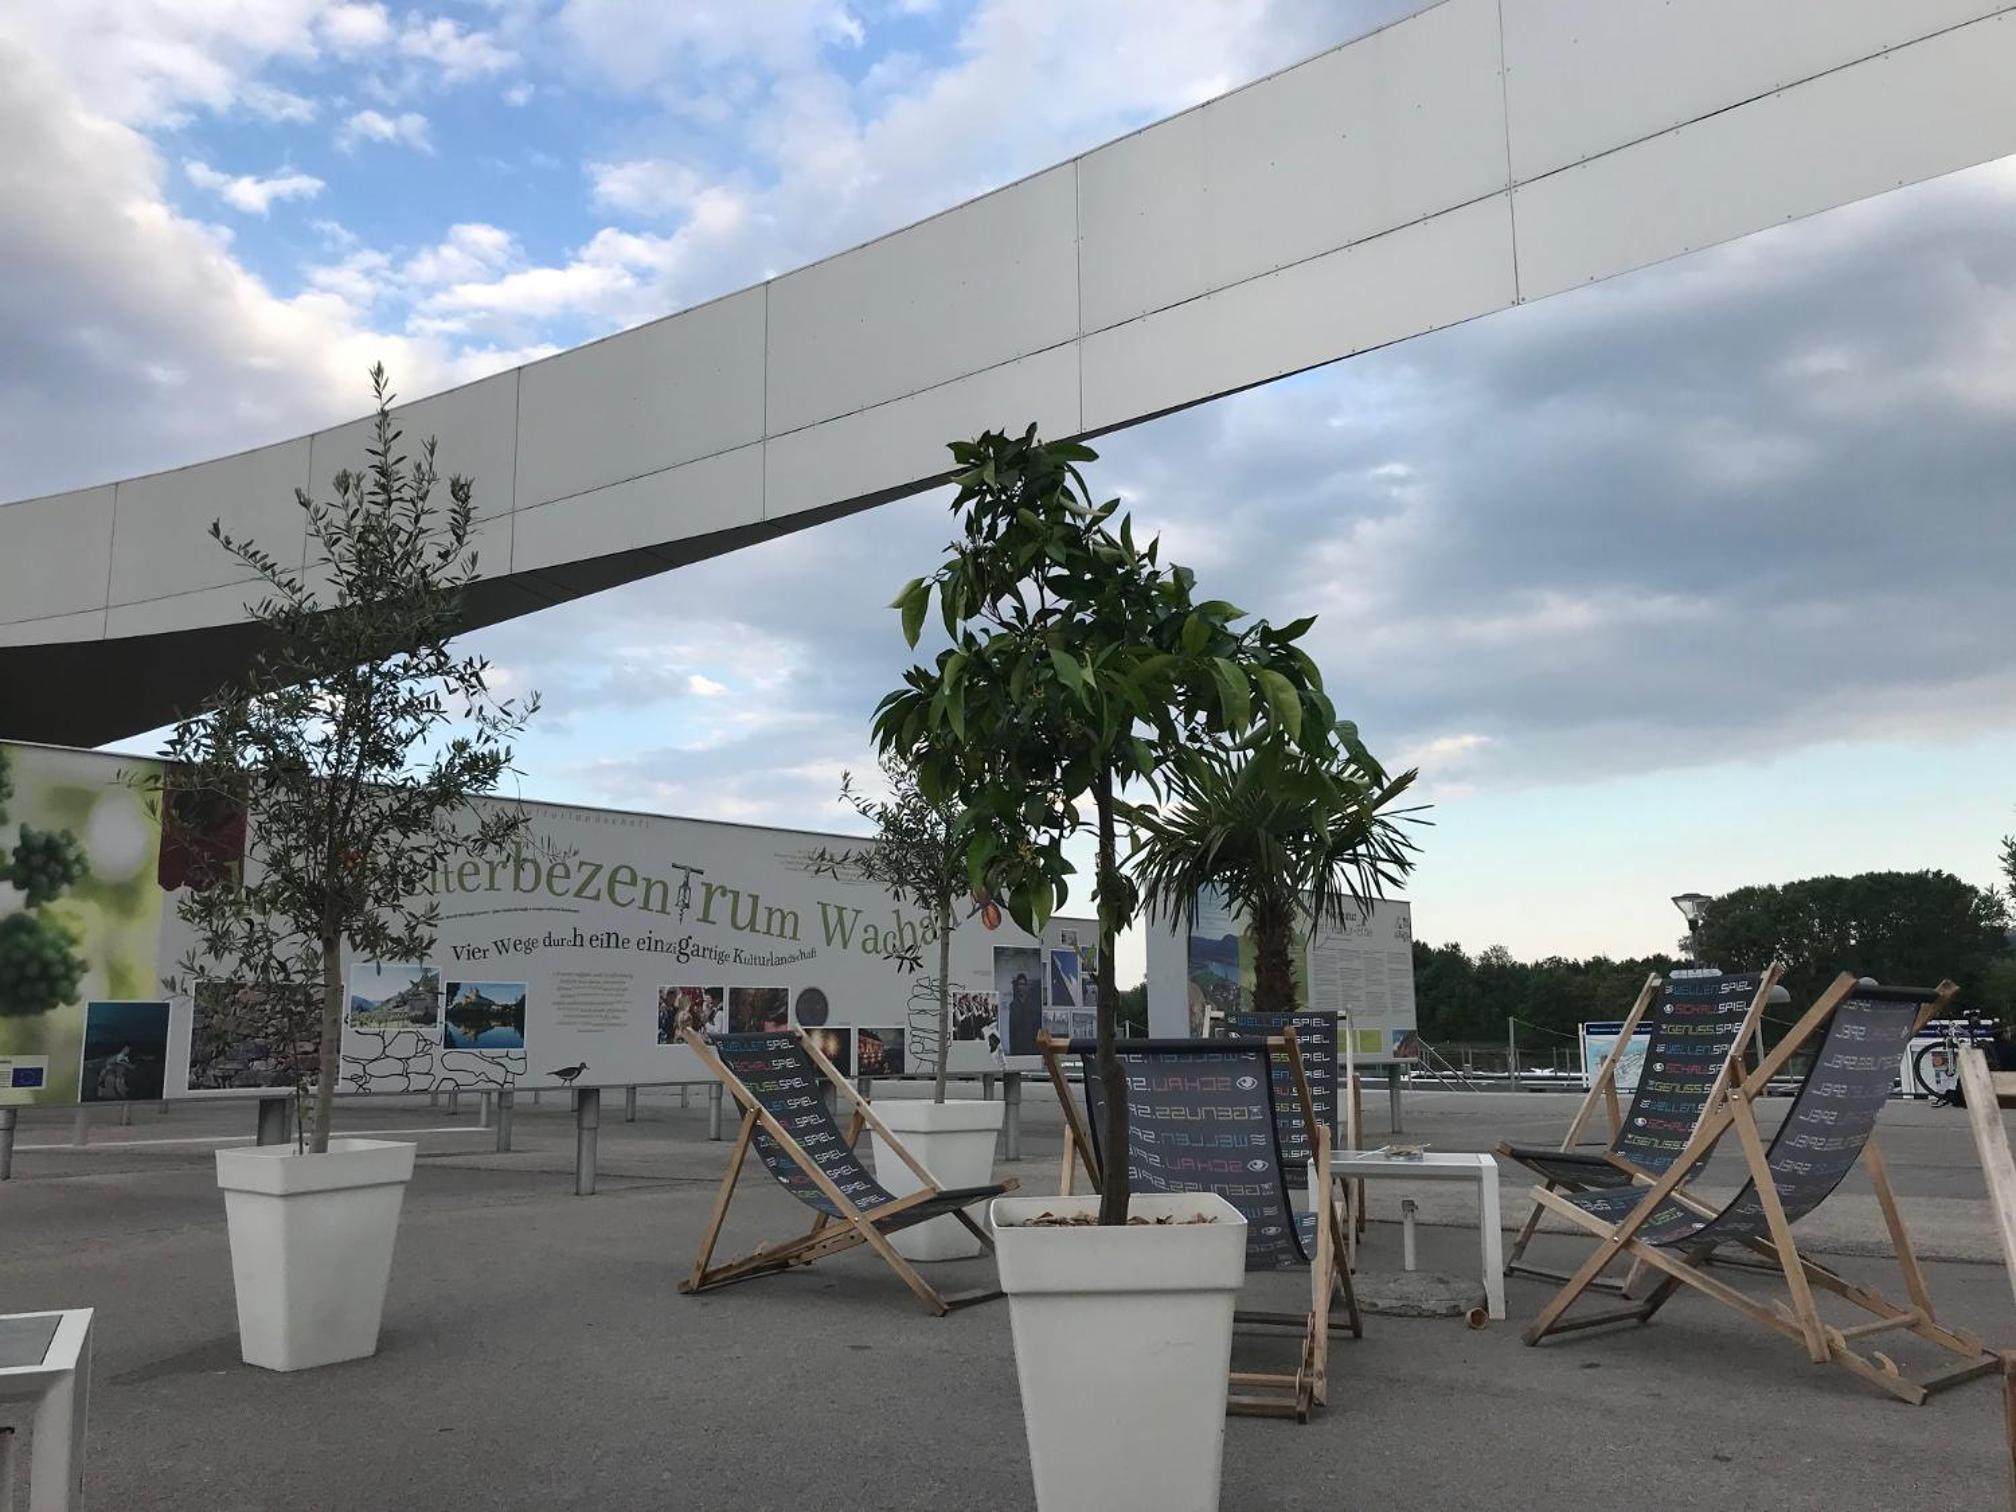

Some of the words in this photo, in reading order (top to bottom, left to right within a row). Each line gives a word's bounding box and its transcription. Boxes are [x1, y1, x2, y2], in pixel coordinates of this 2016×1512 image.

[451, 943, 490, 962] Vier
[492, 936, 539, 955] Wege
[542, 927, 584, 947] durch
[589, 930, 631, 950] eine
[636, 930, 731, 965] einzigartige
